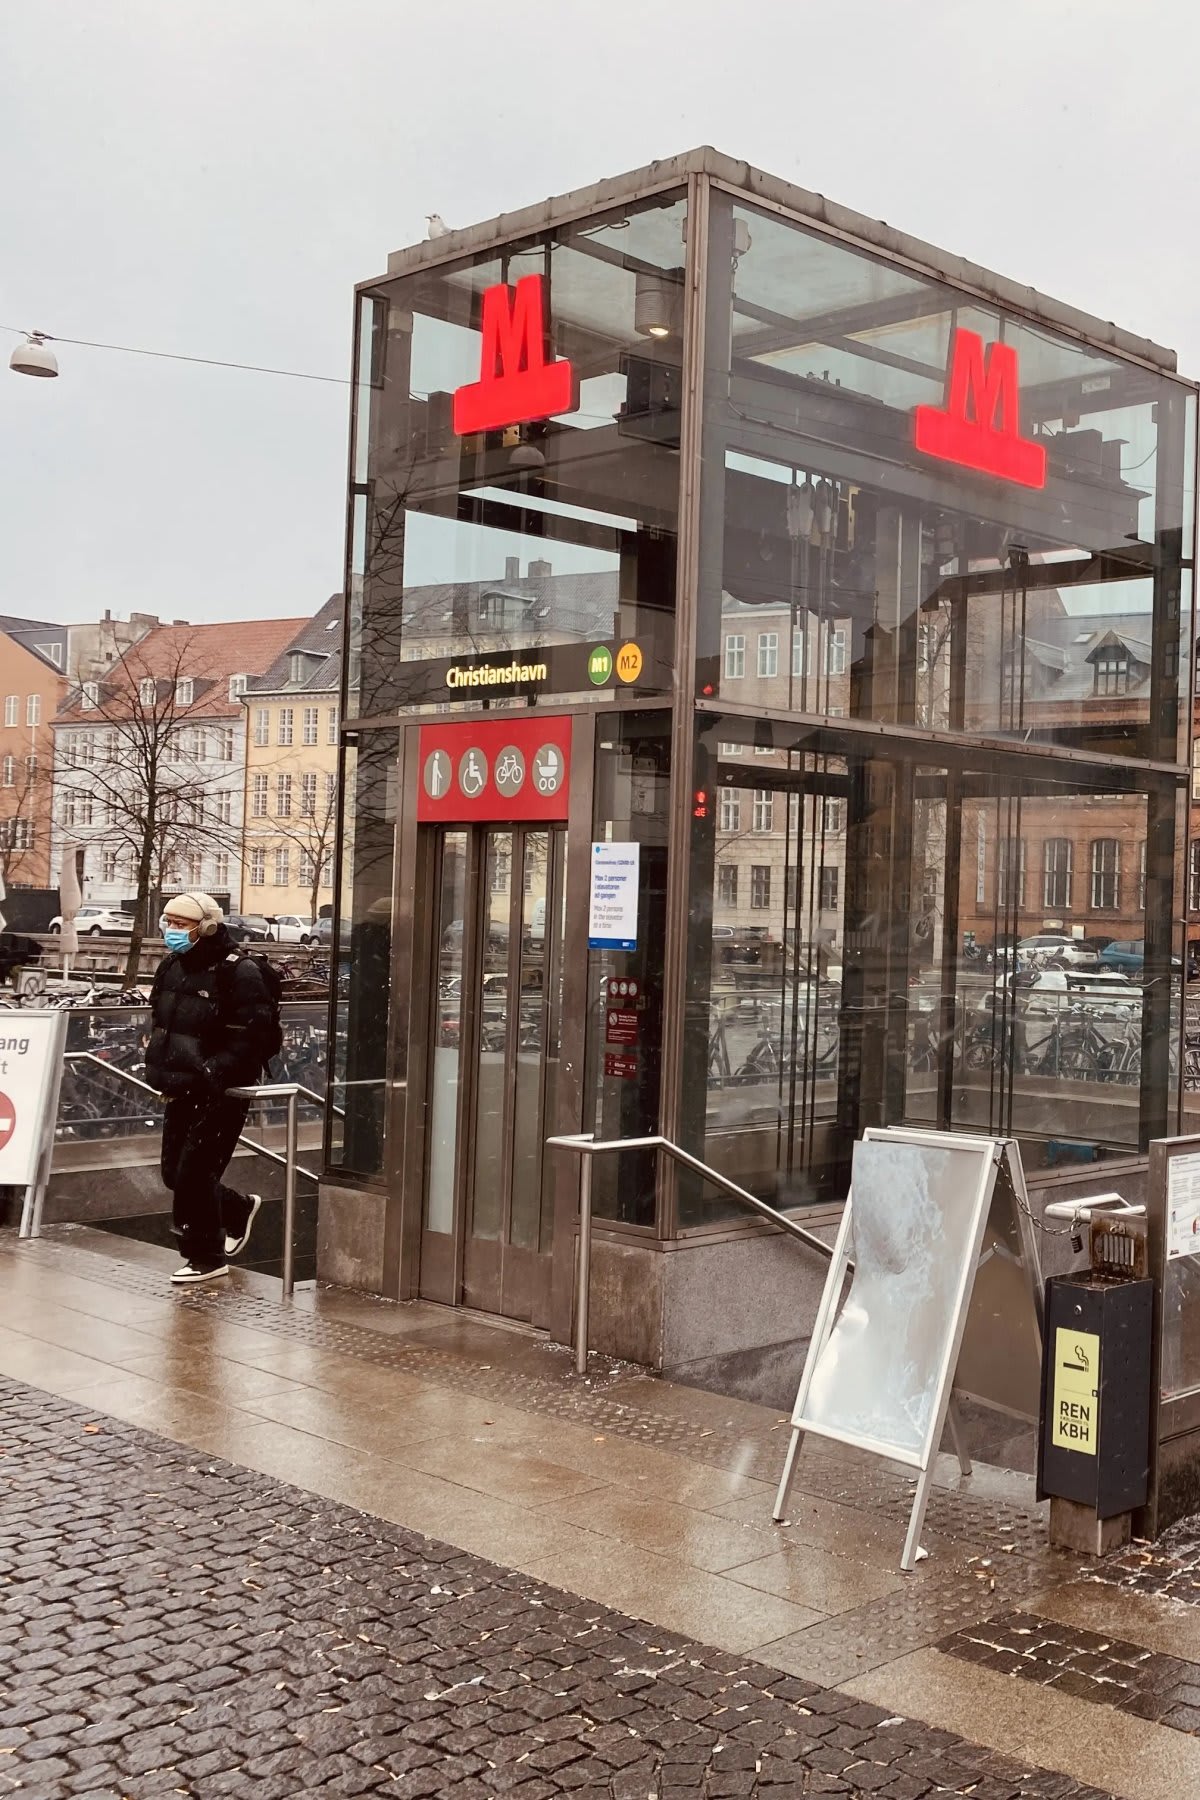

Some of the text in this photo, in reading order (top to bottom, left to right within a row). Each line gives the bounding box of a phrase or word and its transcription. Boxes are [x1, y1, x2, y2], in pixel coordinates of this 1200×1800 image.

[591, 654, 638, 673] M1 M2
[446, 661, 547, 688] Christianshavn
[1060, 1401, 1090, 1421] REN
[1059, 1421, 1089, 1442] KBH
